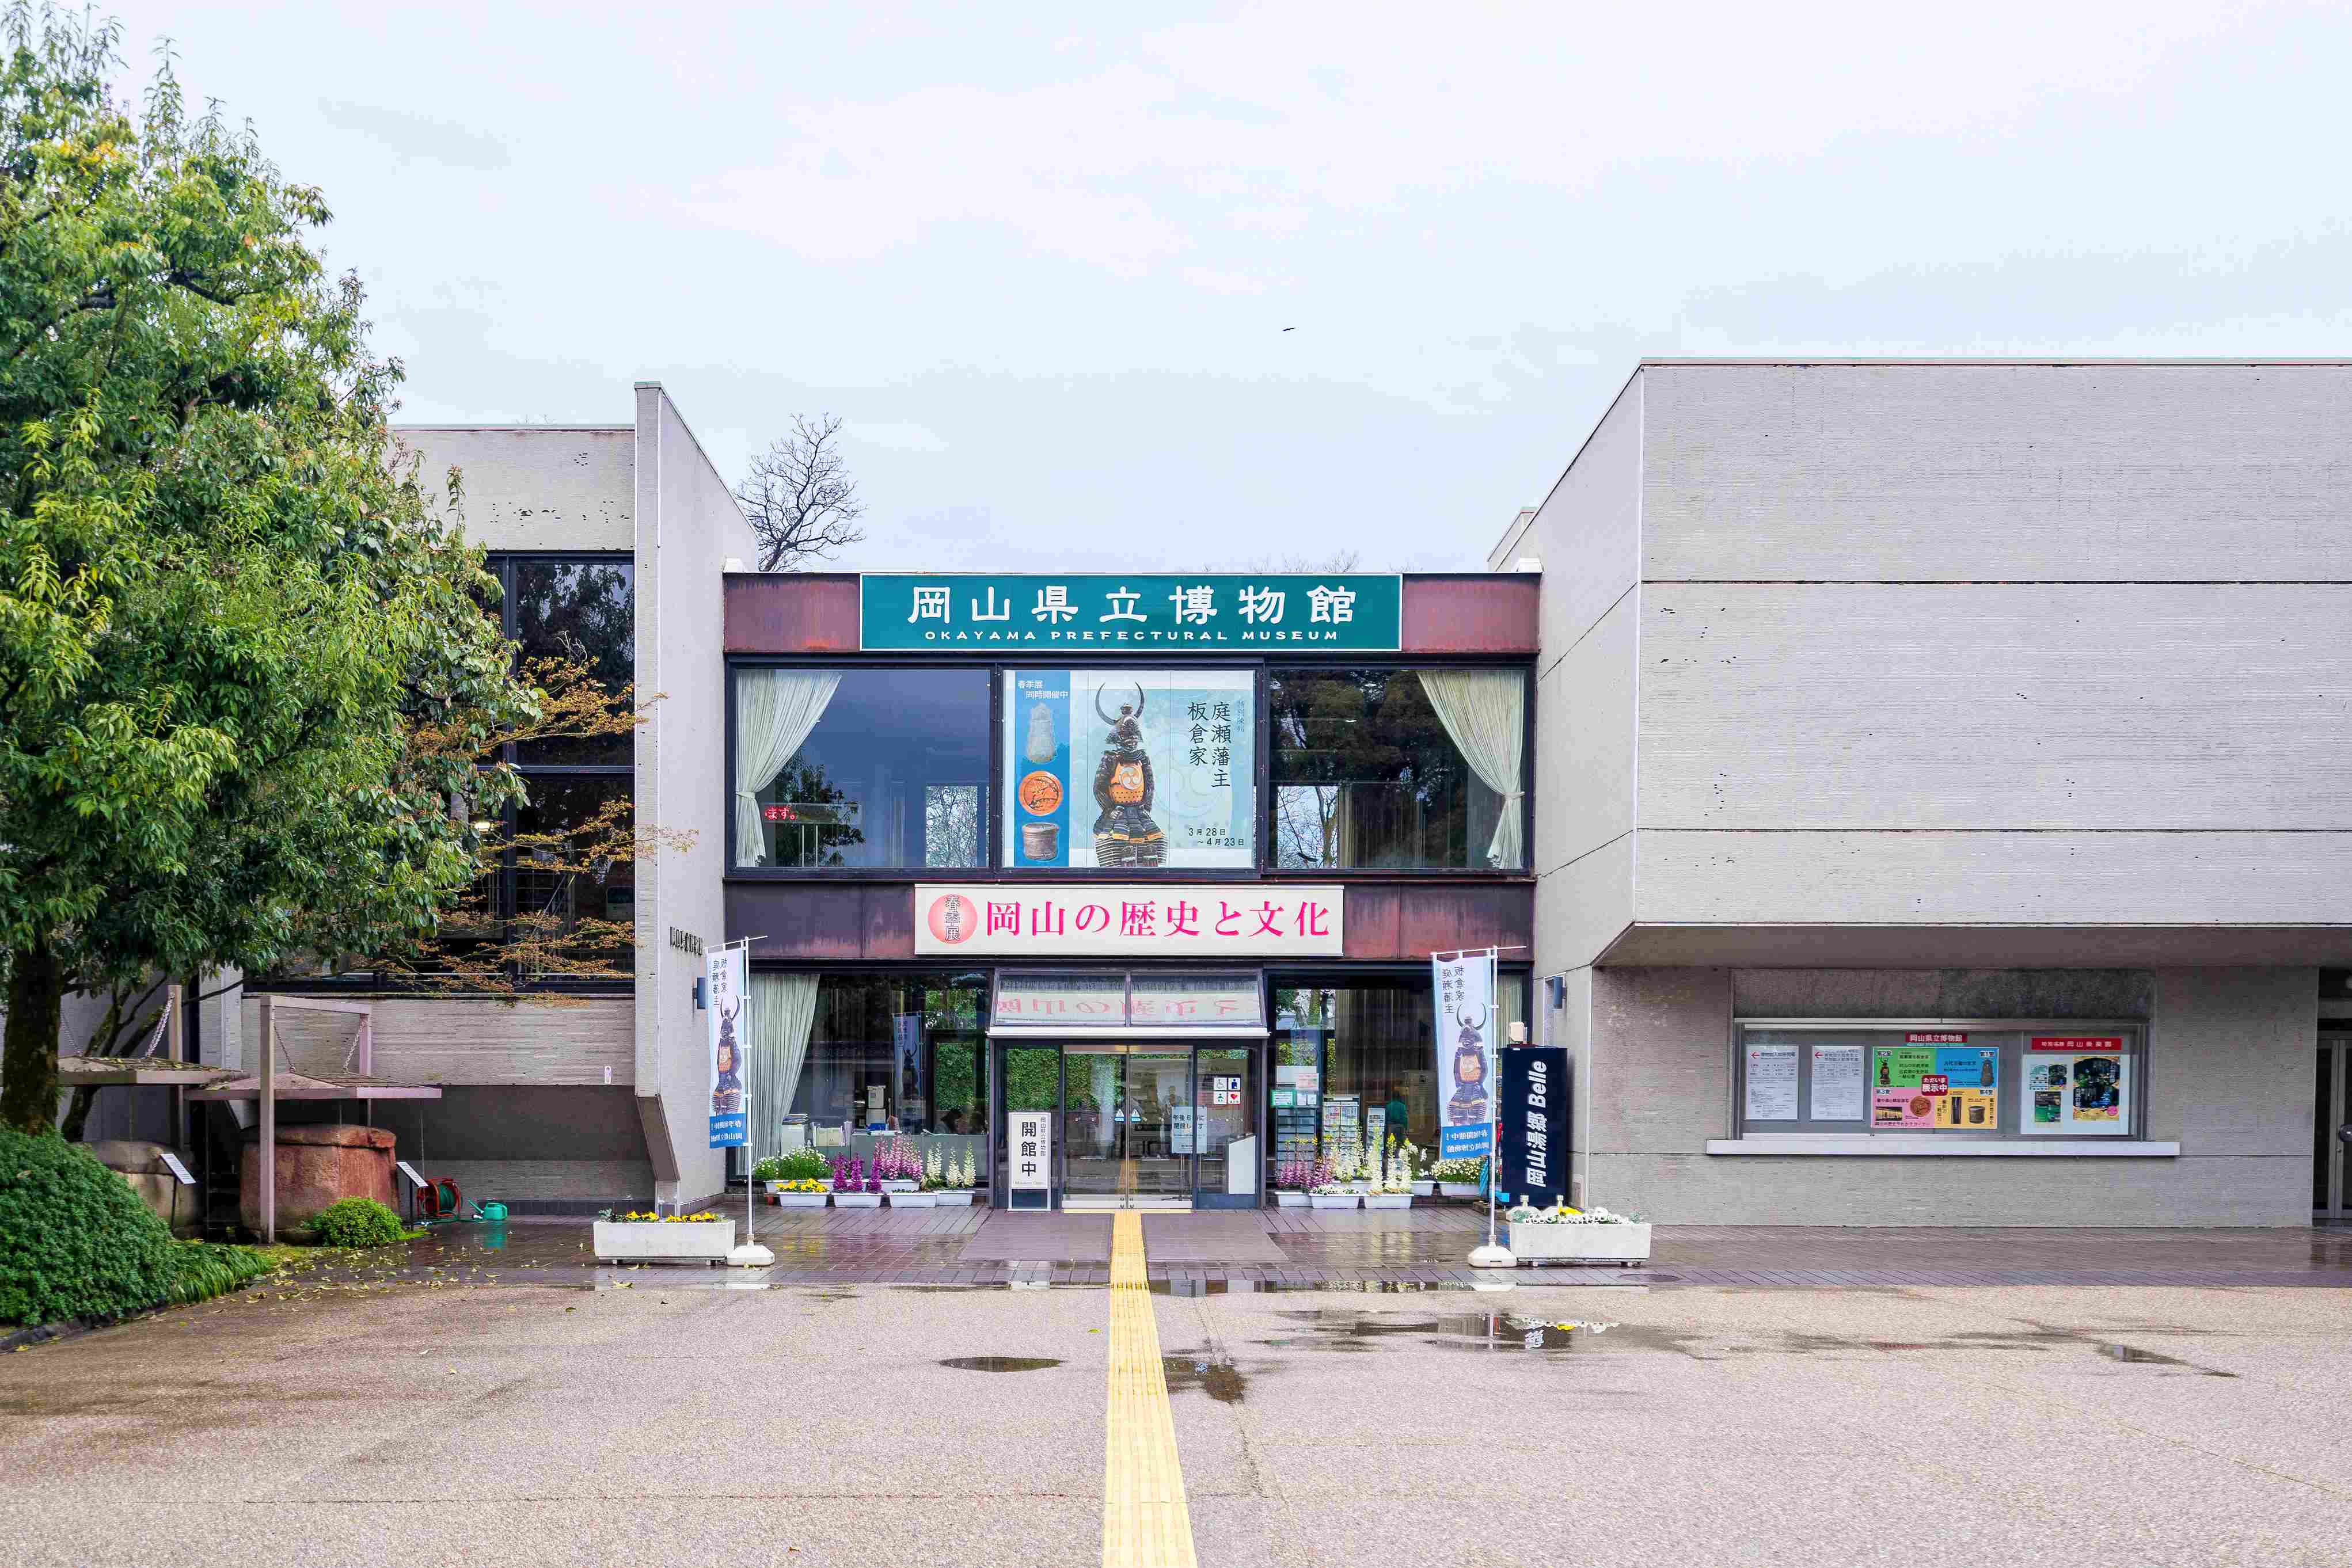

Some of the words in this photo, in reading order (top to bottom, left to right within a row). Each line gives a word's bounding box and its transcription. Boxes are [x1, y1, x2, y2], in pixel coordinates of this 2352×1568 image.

[907, 584, 1357, 625] 岡山県立博物館
[925, 630, 1036, 641] OKAYAMA
[1051, 630, 1228, 641] PREFECTURAL
[1242, 630, 1339, 641] MUSEUM
[1188, 701, 1209, 766] 板倉家
[1211, 701, 1232, 787] 庭瀬藩主
[1188, 828, 1226, 836] 3月28日
[945, 895, 961, 942] 春季展
[985, 900, 1330, 937] 岡山の歴史と文化
[1909, 1034, 1963, 1042] 岡山県立博物館
[1529, 1060, 1547, 1109] Belle
[1922, 1084, 1948, 1093] 展示中
[1021, 1122, 1036, 1177] 開館中
[1526, 1111, 1548, 1187] 岡山湯郷
